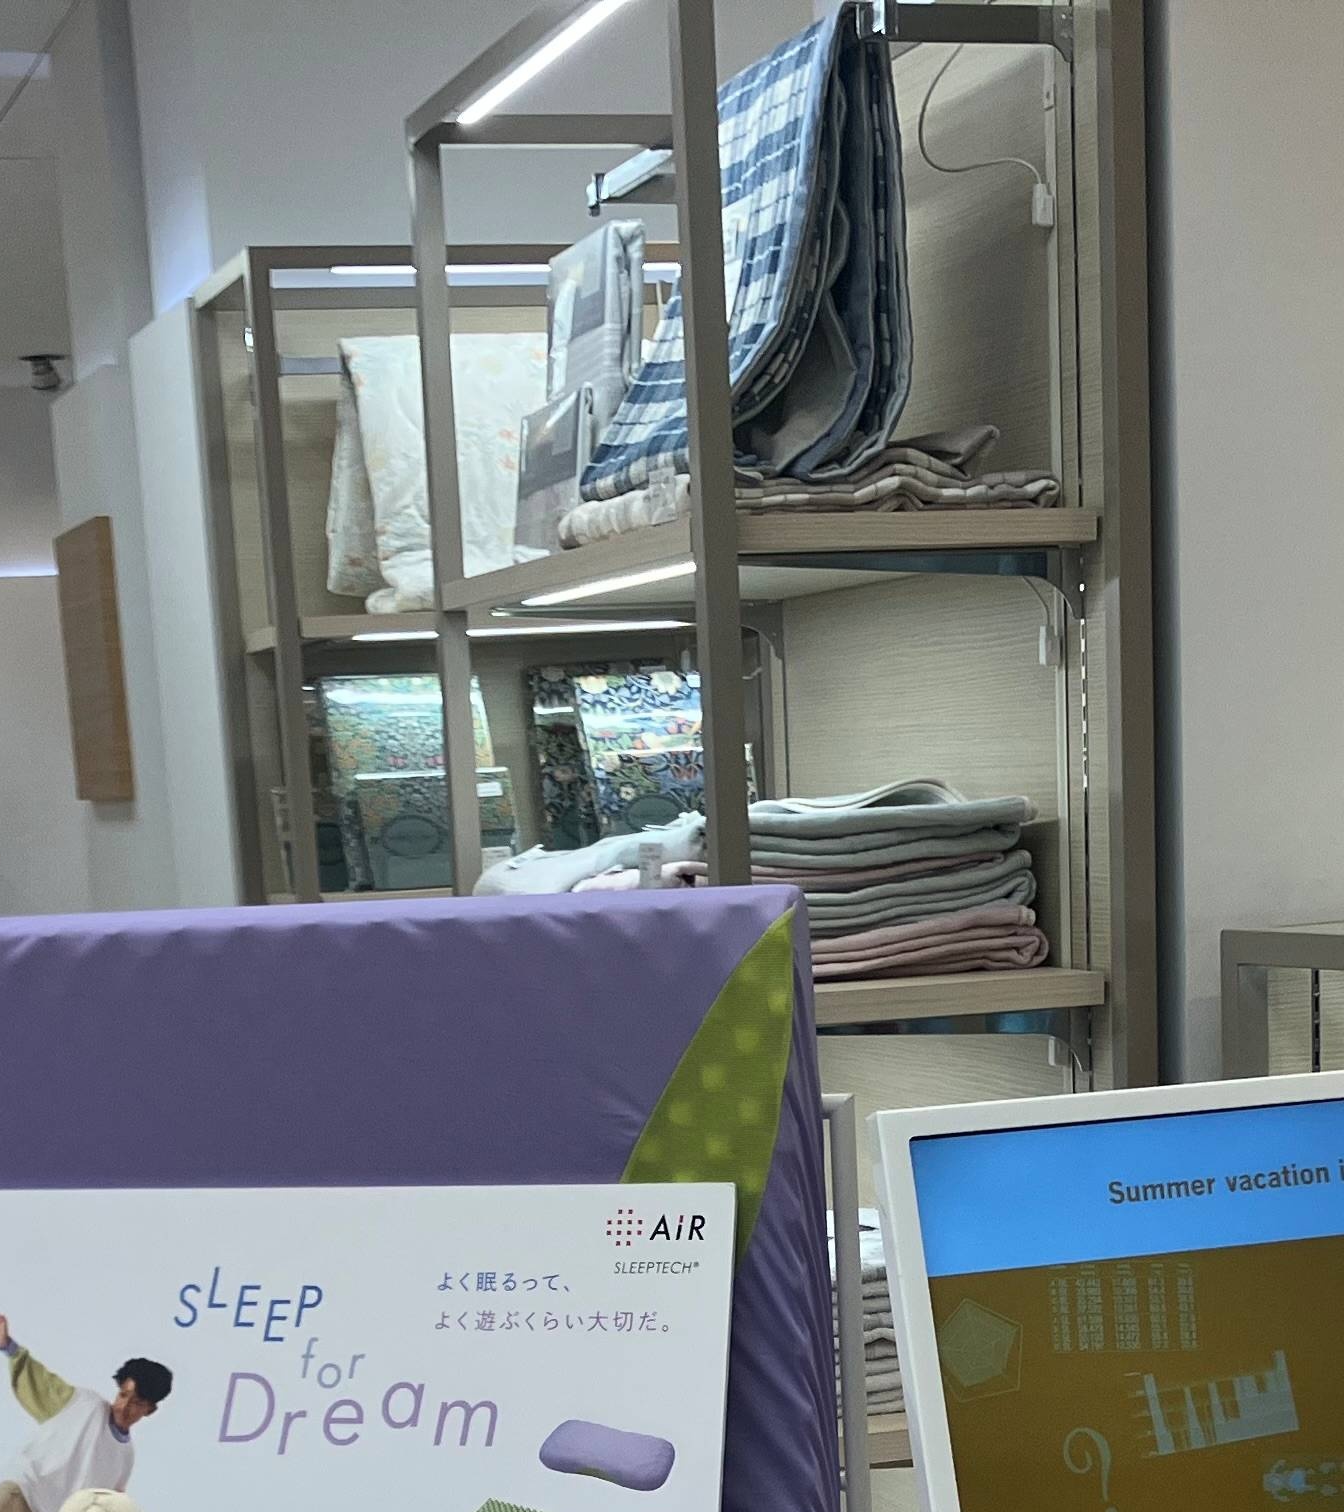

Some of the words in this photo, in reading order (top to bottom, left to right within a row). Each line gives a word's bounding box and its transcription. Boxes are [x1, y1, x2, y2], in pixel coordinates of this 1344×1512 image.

[1108, 1176, 1216, 1204] Summer
[1225, 1164, 1331, 1193] vacation
[436, 1270, 572, 1294] よく眠るって、
[434, 1310, 672, 1334] よく遊ぶくらい大切だ。
[299, 1336, 366, 1390] for
[218, 1370, 499, 1456] Dream
